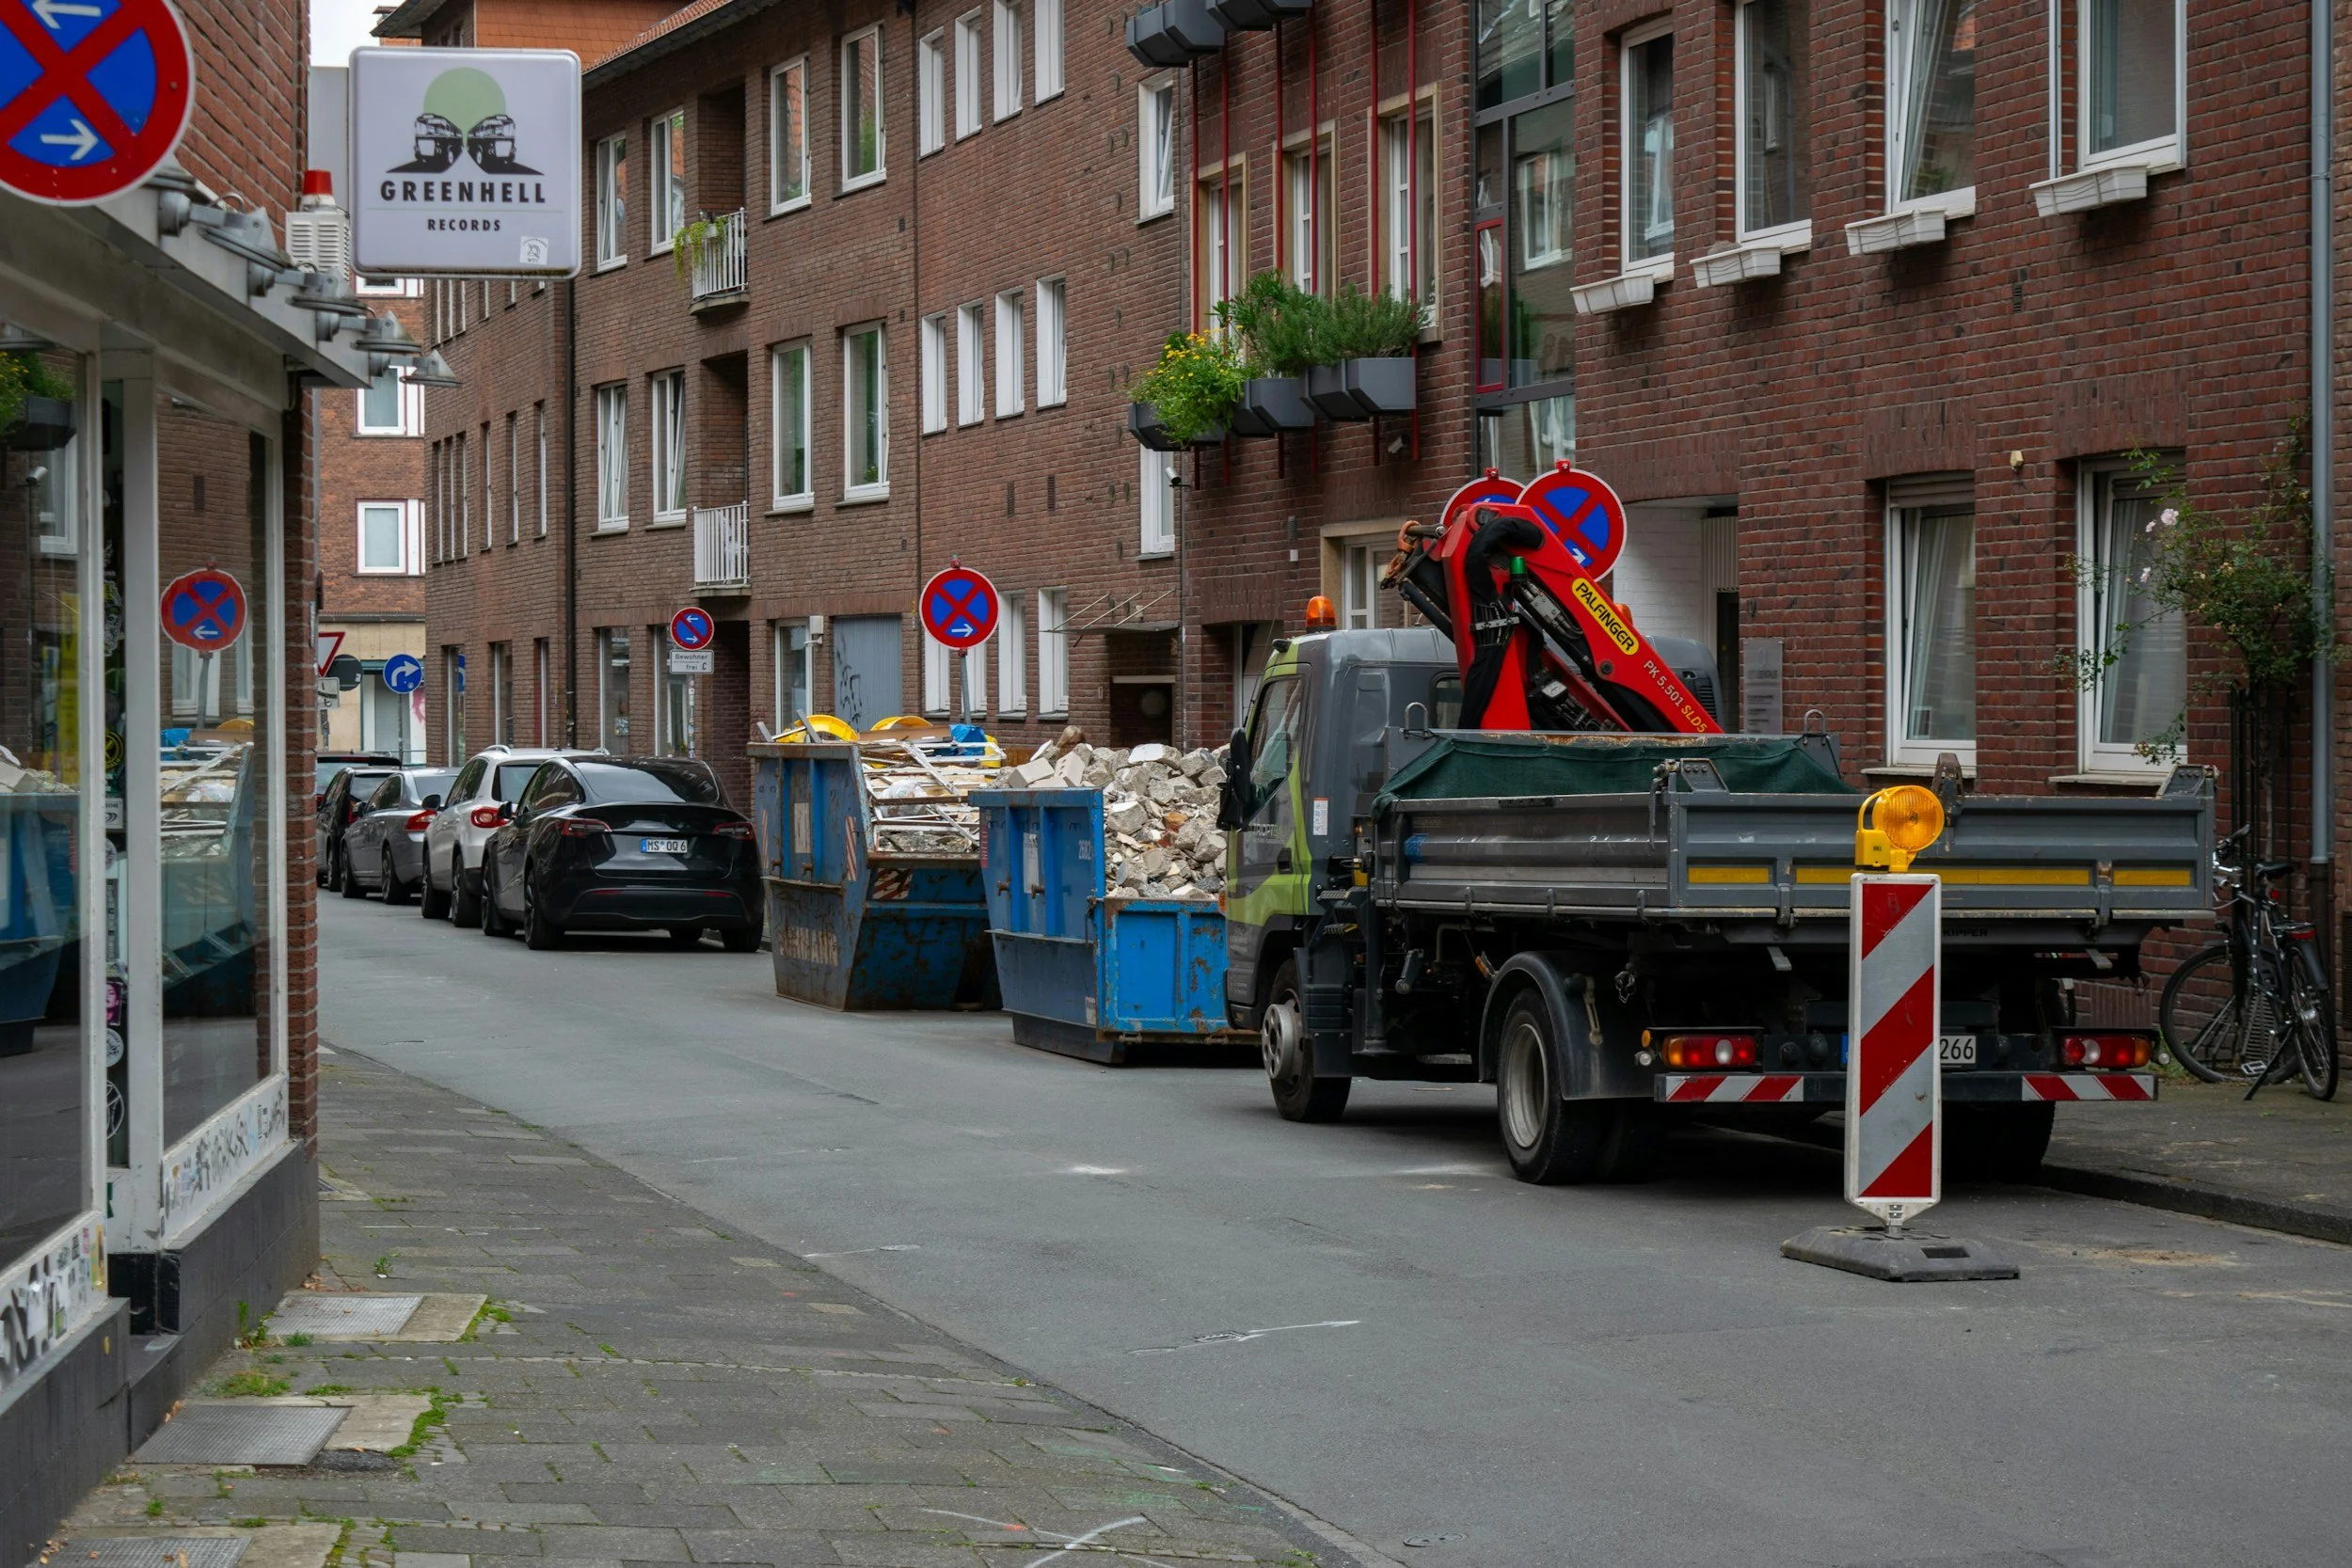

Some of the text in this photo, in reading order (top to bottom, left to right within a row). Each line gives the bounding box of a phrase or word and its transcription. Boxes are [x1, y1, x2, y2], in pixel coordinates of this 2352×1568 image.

[380, 180, 546, 203] GREENHELL
[427, 218, 501, 231] RECORDS
[1575, 581, 1634, 652] PALFINGER
[1644, 660, 1708, 734] PK 5.501 SLD5
[647, 840, 660, 851] MS
[680, 841, 686, 851] 6
[1944, 927, 1988, 937] KIPPER
[1940, 1038, 1974, 1060] 266
